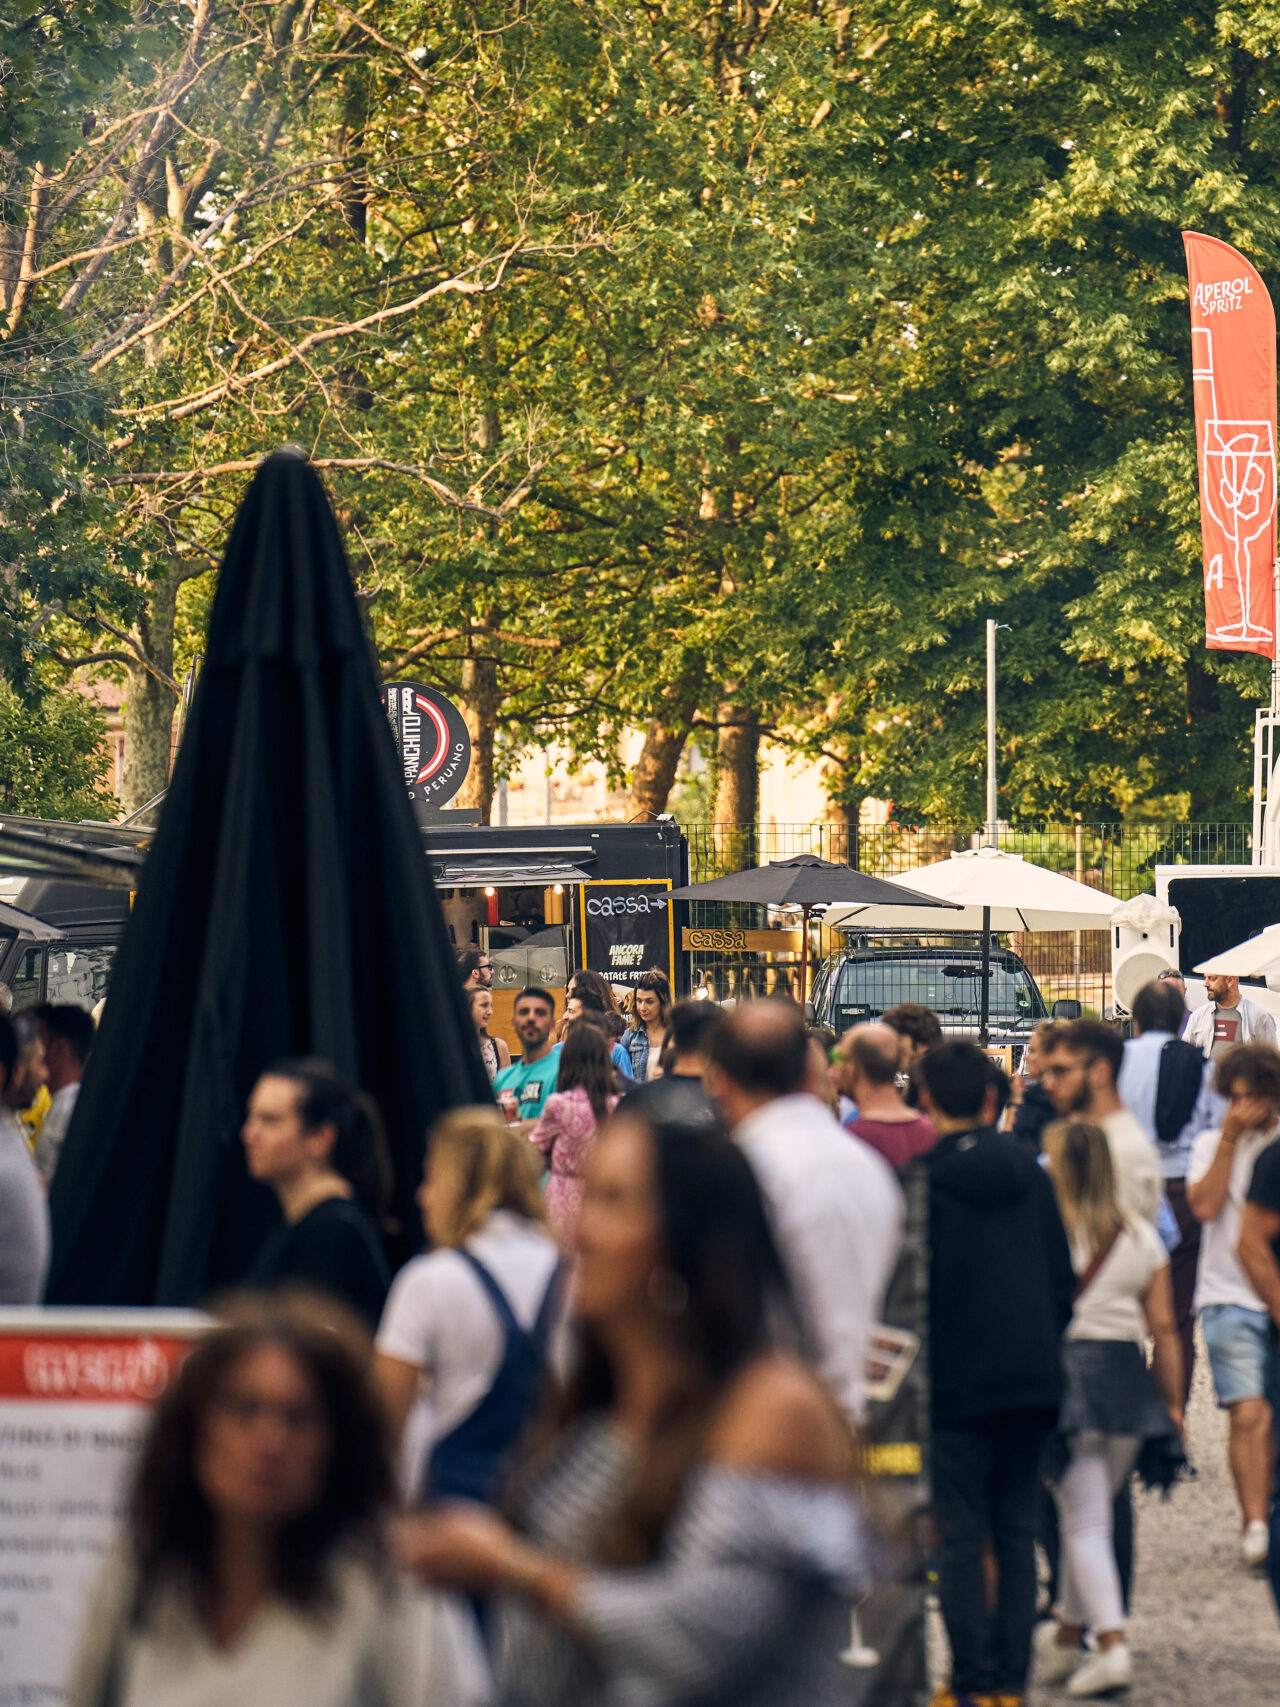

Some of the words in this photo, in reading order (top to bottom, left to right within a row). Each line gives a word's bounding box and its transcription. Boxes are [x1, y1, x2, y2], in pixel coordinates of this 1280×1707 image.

[1193, 277, 1253, 307] APEROL
[402, 715, 421, 778] PANCHITO
[423, 742, 465, 795] PERUANO
[609, 944, 645, 956] ANCORA
[611, 954, 635, 966] FAME
